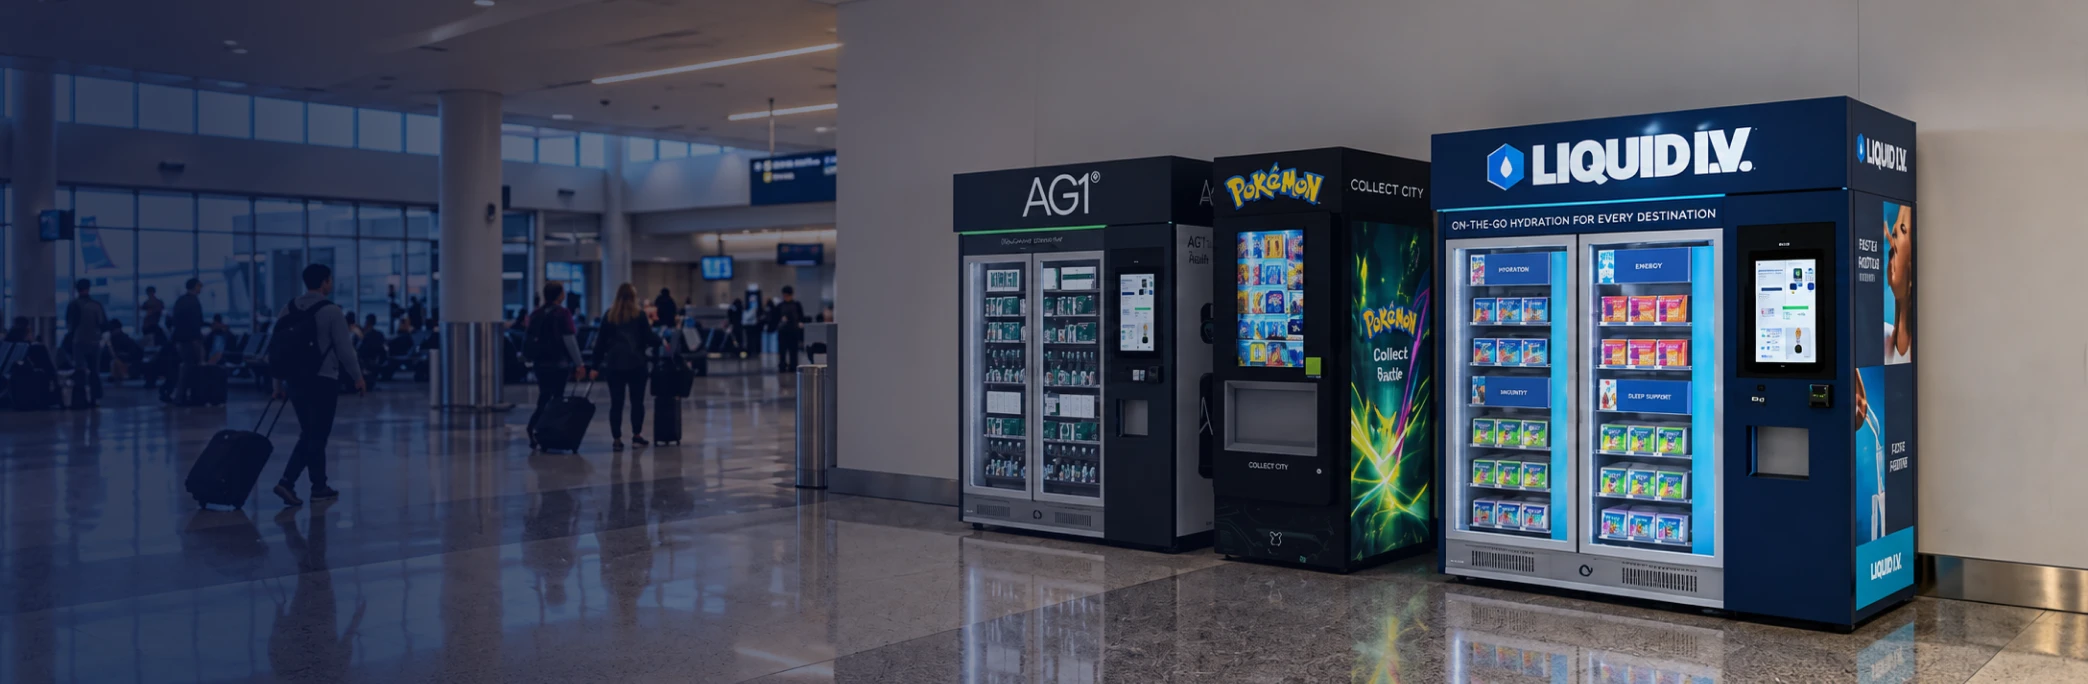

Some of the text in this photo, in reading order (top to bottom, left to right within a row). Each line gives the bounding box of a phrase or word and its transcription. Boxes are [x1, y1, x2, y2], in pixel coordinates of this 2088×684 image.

[1532, 133, 1691, 186] LIQUID
[1866, 137, 1896, 170] LIQUID
[1350, 178, 1424, 199] COLLECT CITY
[1451, 208, 1717, 231] ON-THE-GO HYDRATION FOR EVERY DESTINATION
[1373, 346, 1409, 362] Collect
[1248, 461, 1289, 471] COLLECT CITY
[1870, 555, 1893, 581] LIQUID
